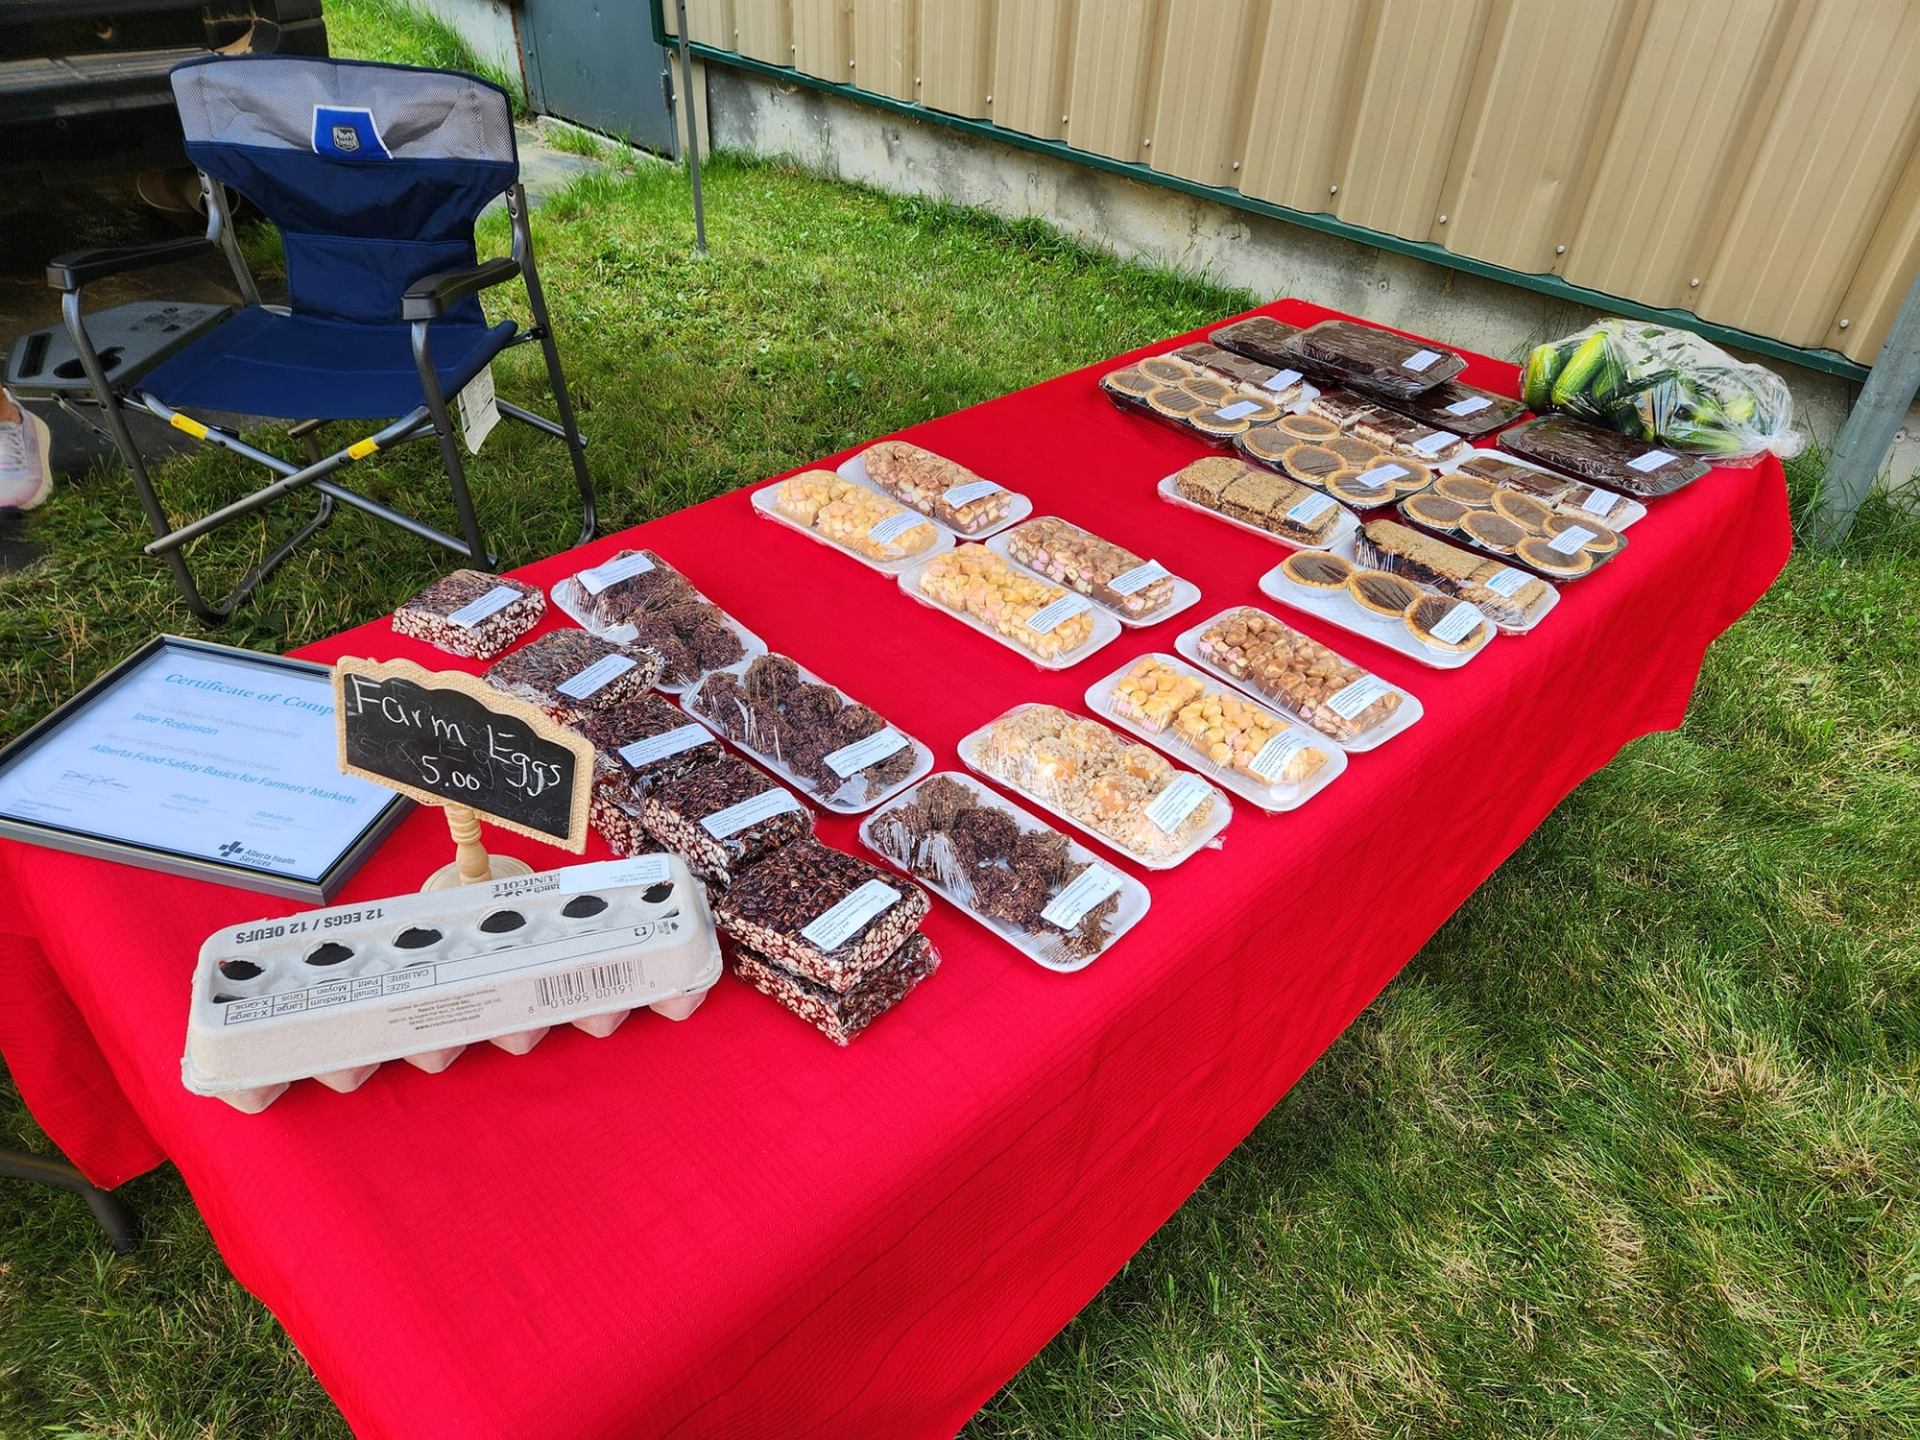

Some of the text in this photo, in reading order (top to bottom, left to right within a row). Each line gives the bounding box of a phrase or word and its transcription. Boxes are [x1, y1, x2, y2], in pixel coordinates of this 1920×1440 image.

[165, 673, 254, 697] Certificate
[257, 692, 283, 704] of
[161, 717, 218, 736] Robinson
[351, 675, 467, 747] Farm
[487, 724, 562, 797] Eggs
[89, 744, 133, 758] Alberta
[133, 752, 166, 764] Food
[163, 759, 202, 773] Safety
[202, 766, 237, 779] Basics
[239, 773, 257, 782] for
[309, 788, 357, 804] Markets
[421, 755, 480, 790] 5.00
[240, 855, 272, 866] Services
[245, 849, 296, 864] Alberta Health
[236, 908, 384, 944] 12 EGGS / 12 OEUFS
[235, 969, 429, 1010] CALIBRE: Petit Moyen Gros X-Gros
[310, 994, 347, 1006] Medium
[354, 988, 379, 999] Small
[550, 993, 590, 1009] 01895
[595, 984, 633, 999] 00191
[649, 980, 656, 988] 8
[230, 1009, 268, 1021] X-Large
[276, 1003, 303, 1012] Large
